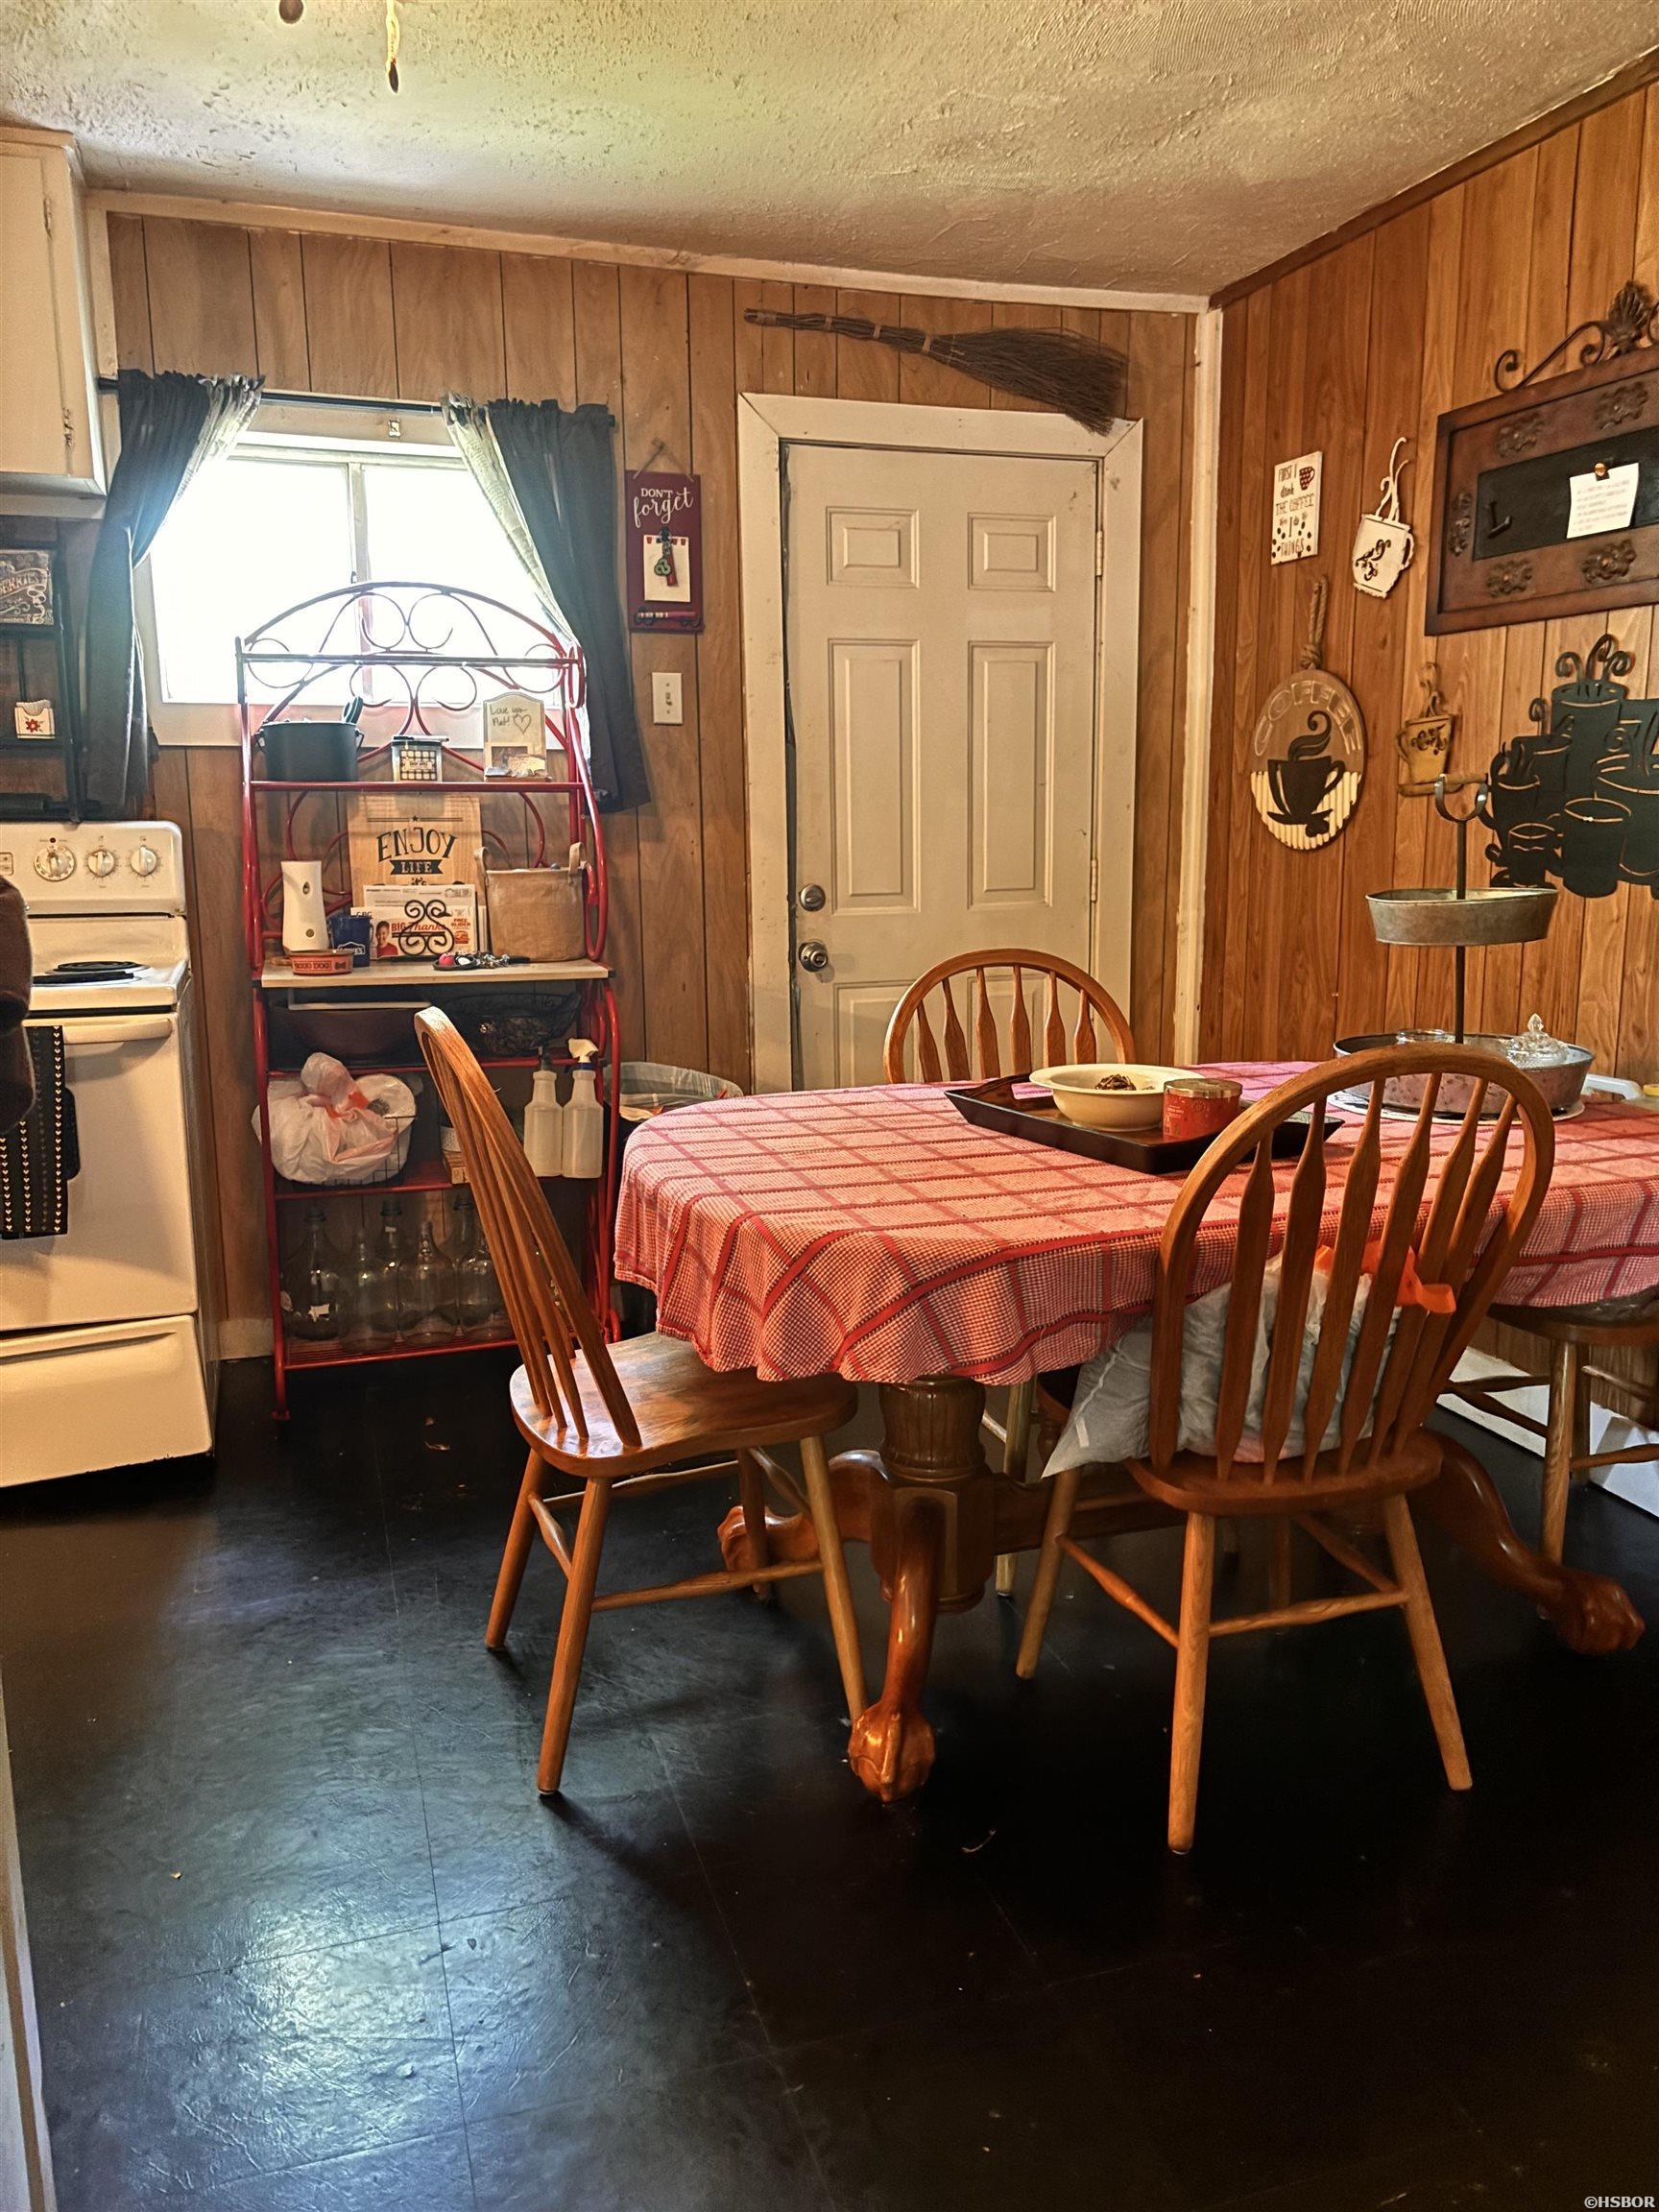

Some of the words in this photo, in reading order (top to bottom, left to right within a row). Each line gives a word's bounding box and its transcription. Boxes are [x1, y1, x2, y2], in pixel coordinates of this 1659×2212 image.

[640, 488, 673, 499] DON'T
[634, 487, 694, 529] forget
[490, 705, 509, 715] Love
[1254, 680, 1362, 757] COFFEE
[375, 827, 458, 862] ENJOY
[400, 861, 432, 874] LIFE
[392, 922, 405, 931] BIG
